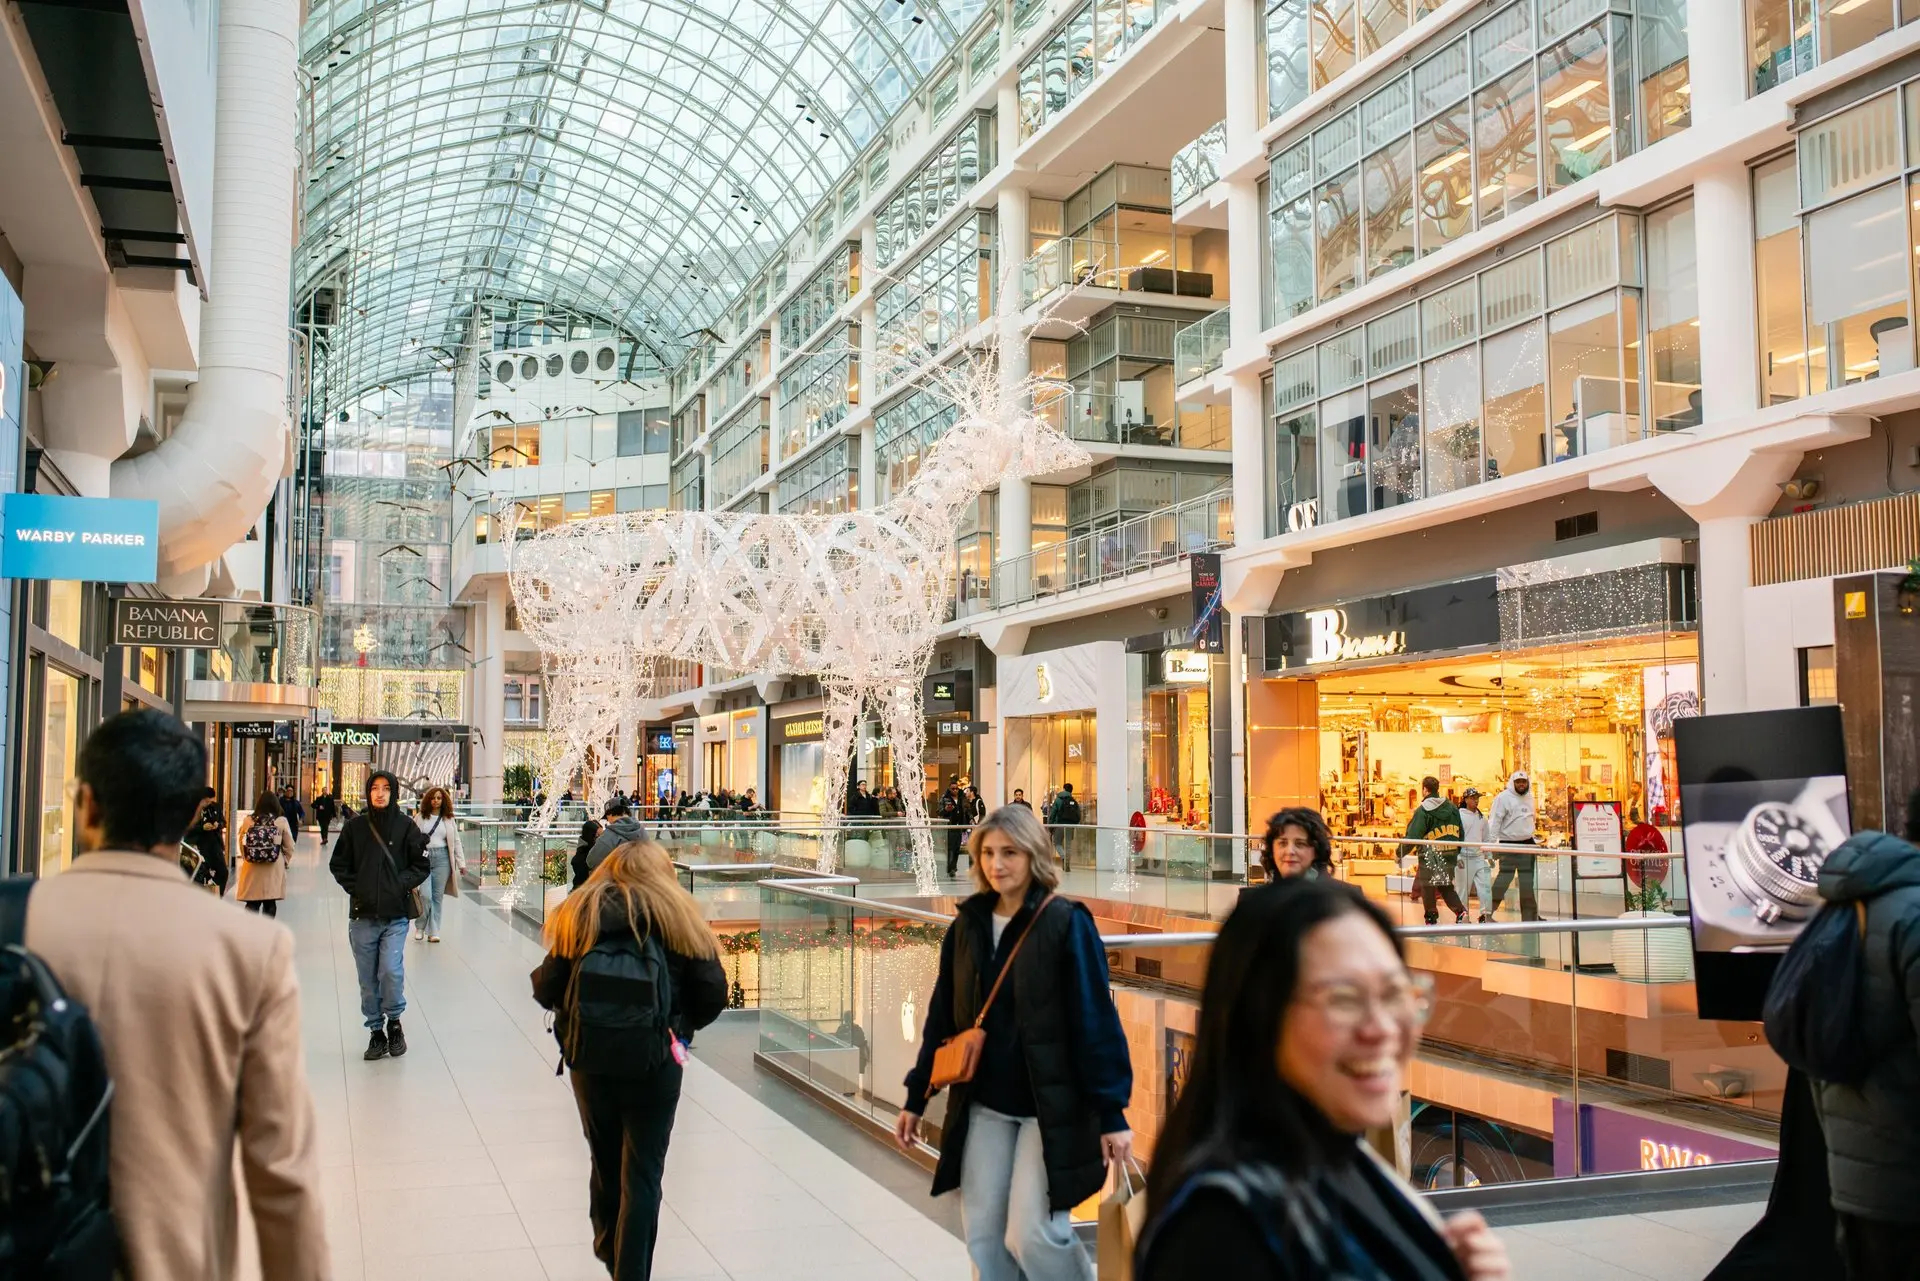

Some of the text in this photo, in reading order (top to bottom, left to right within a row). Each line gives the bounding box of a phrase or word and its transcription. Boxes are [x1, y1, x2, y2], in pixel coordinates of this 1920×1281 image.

[16, 529, 145, 546] WARBY PARKER
[129, 606, 209, 623] BANANA
[122, 624, 214, 641] REPUBLIC
[1169, 660, 1206, 673] Browns
[346, 728, 380, 746] ROSEN
